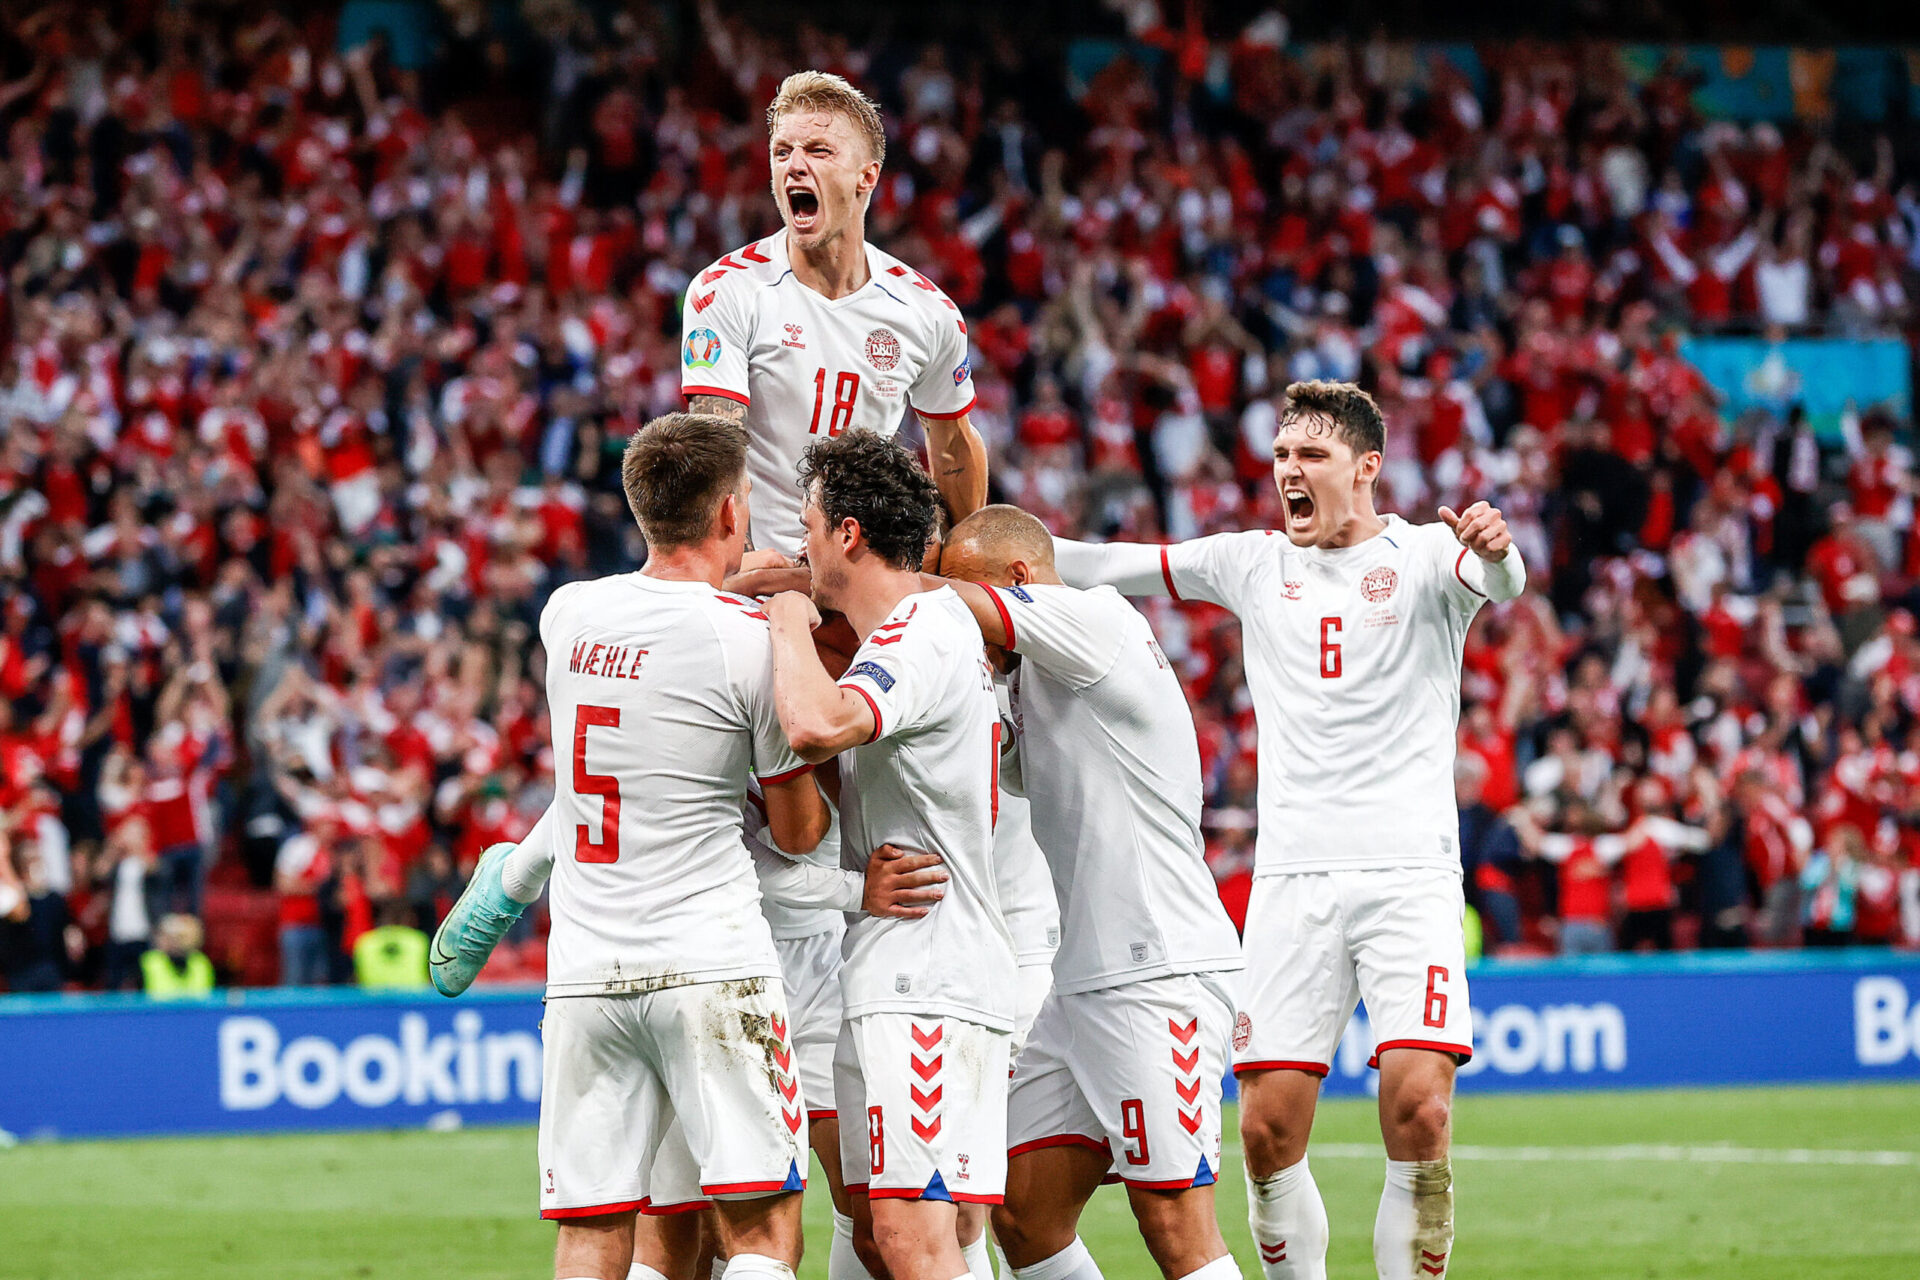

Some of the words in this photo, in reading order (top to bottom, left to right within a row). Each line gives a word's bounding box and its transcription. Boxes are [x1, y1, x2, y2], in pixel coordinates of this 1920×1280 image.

[872, 343, 893, 357] DBU
[809, 367, 860, 437] 18
[569, 641, 649, 680] MÆHLE
[856, 664, 892, 688] RESPECT
[1320, 616, 1343, 679] 6
[573, 703, 621, 864] 5
[1423, 965, 1449, 1029] 6
[219, 1010, 542, 1111] Bookin
[868, 1105, 885, 1175] 8
[1121, 1099, 1150, 1166] 9
